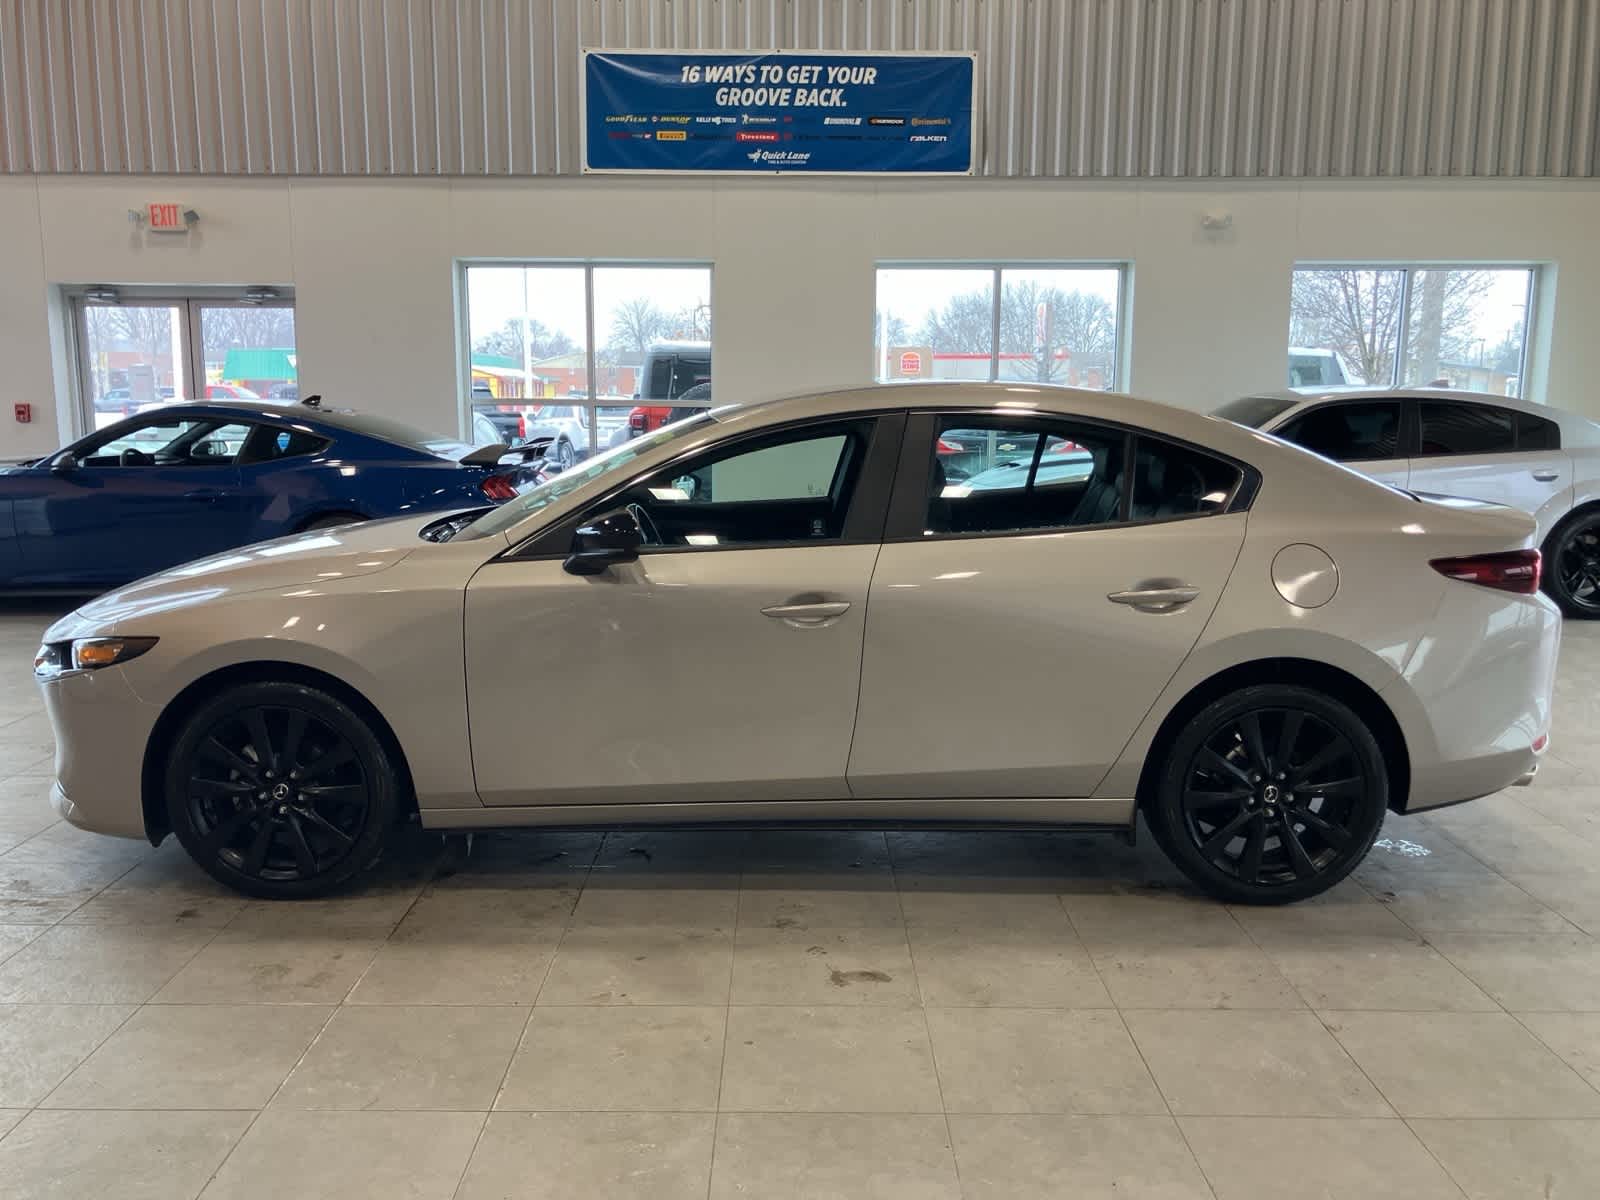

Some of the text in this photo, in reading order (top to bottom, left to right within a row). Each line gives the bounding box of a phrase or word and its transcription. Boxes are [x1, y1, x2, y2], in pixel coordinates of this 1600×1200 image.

[681, 65, 877, 85] 16 WAYS TO GET YOUR
[715, 87, 847, 107] GROOVE BACK.
[761, 151, 811, 160] Quick Lane
[150, 204, 176, 227] EXIT
